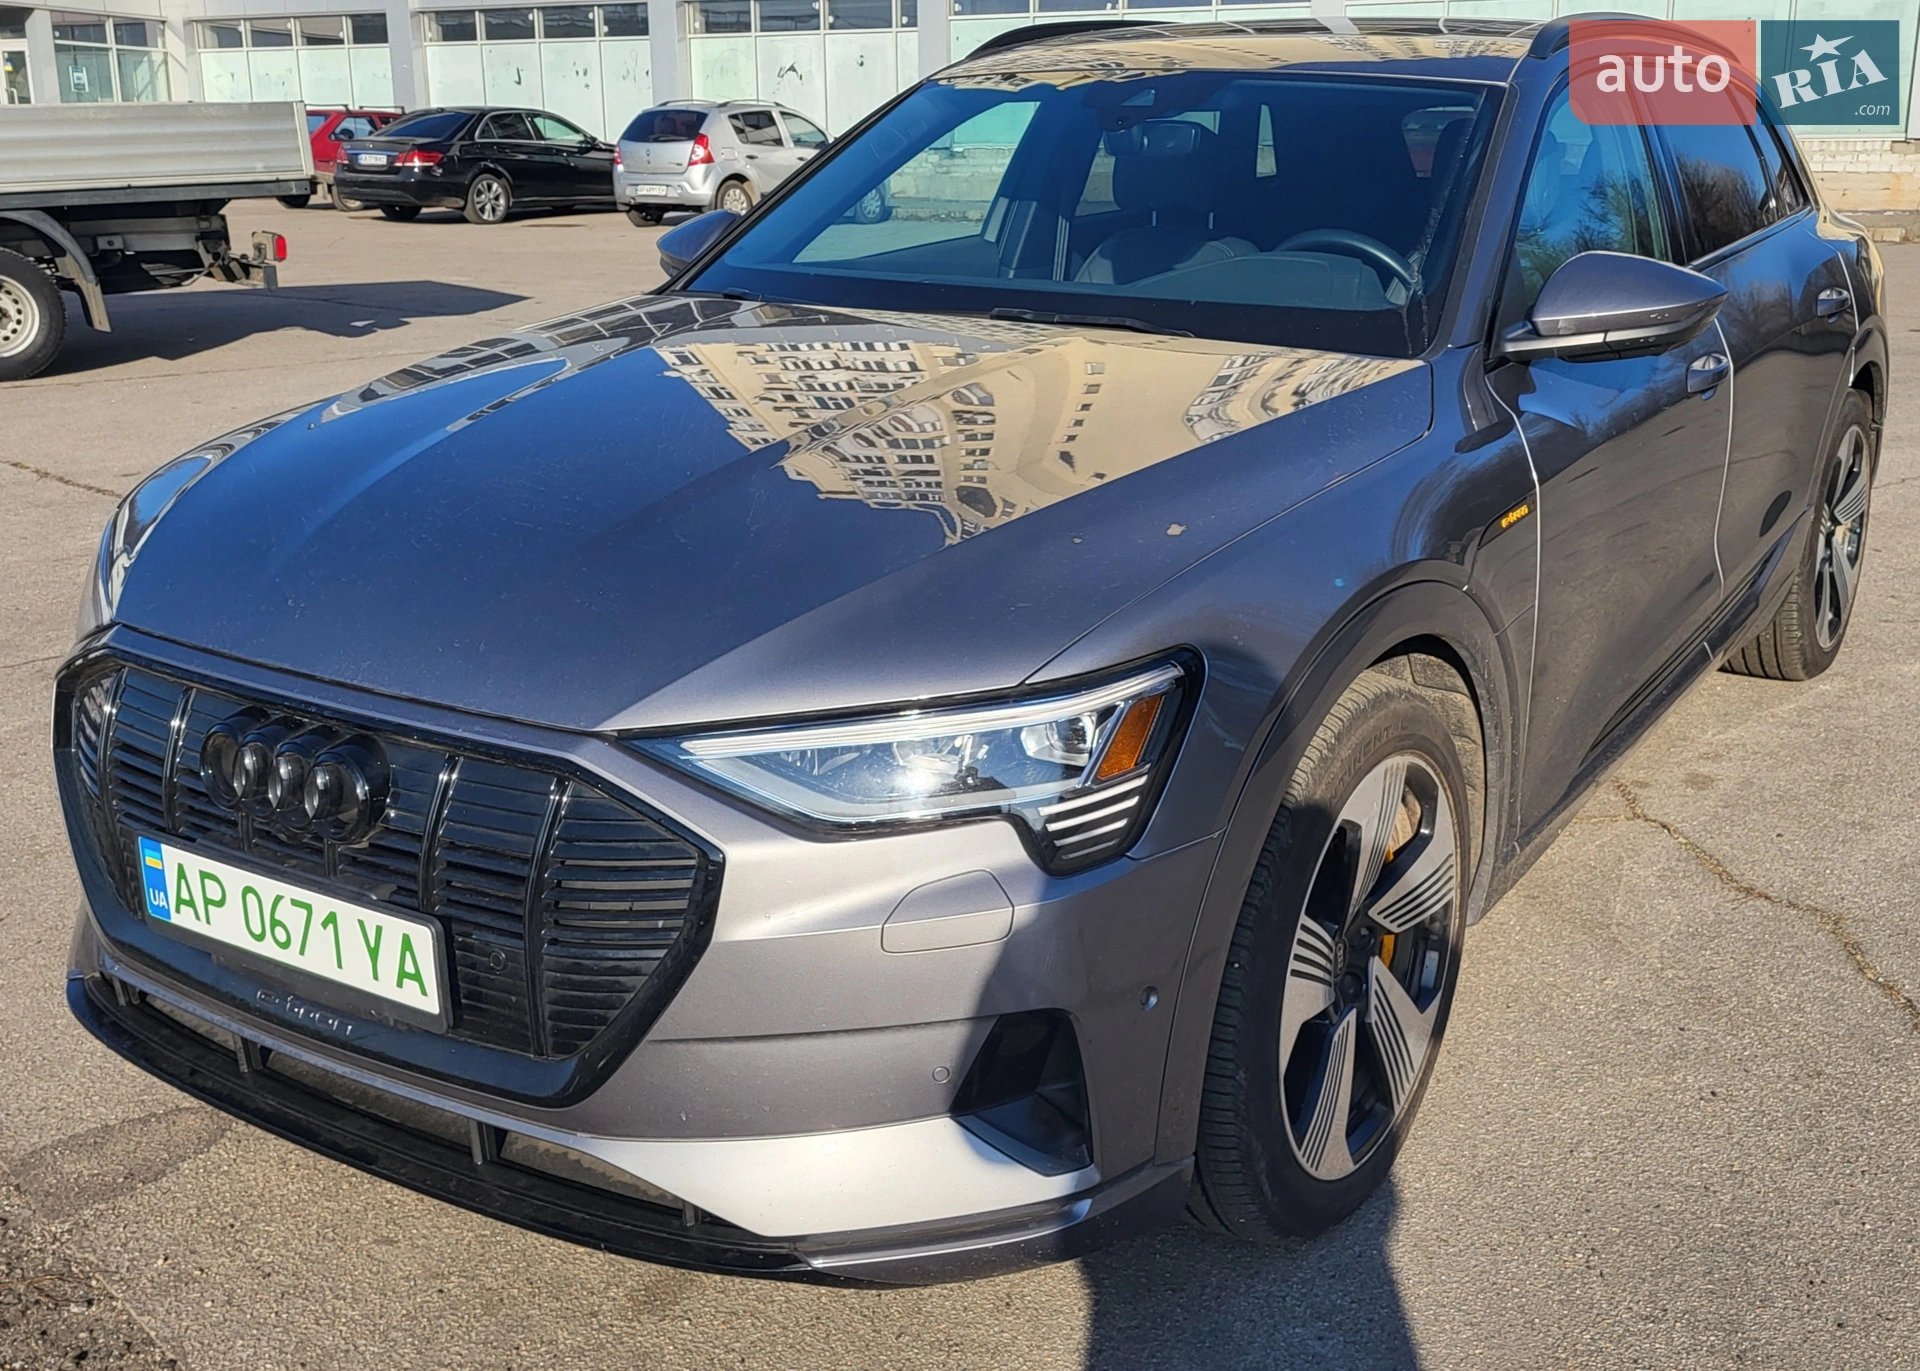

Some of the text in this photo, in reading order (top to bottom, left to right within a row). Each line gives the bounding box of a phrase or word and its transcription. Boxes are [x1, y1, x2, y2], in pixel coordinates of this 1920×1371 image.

[150, 888, 169, 910] UA
[175, 862, 429, 997] AP 0671 YA
